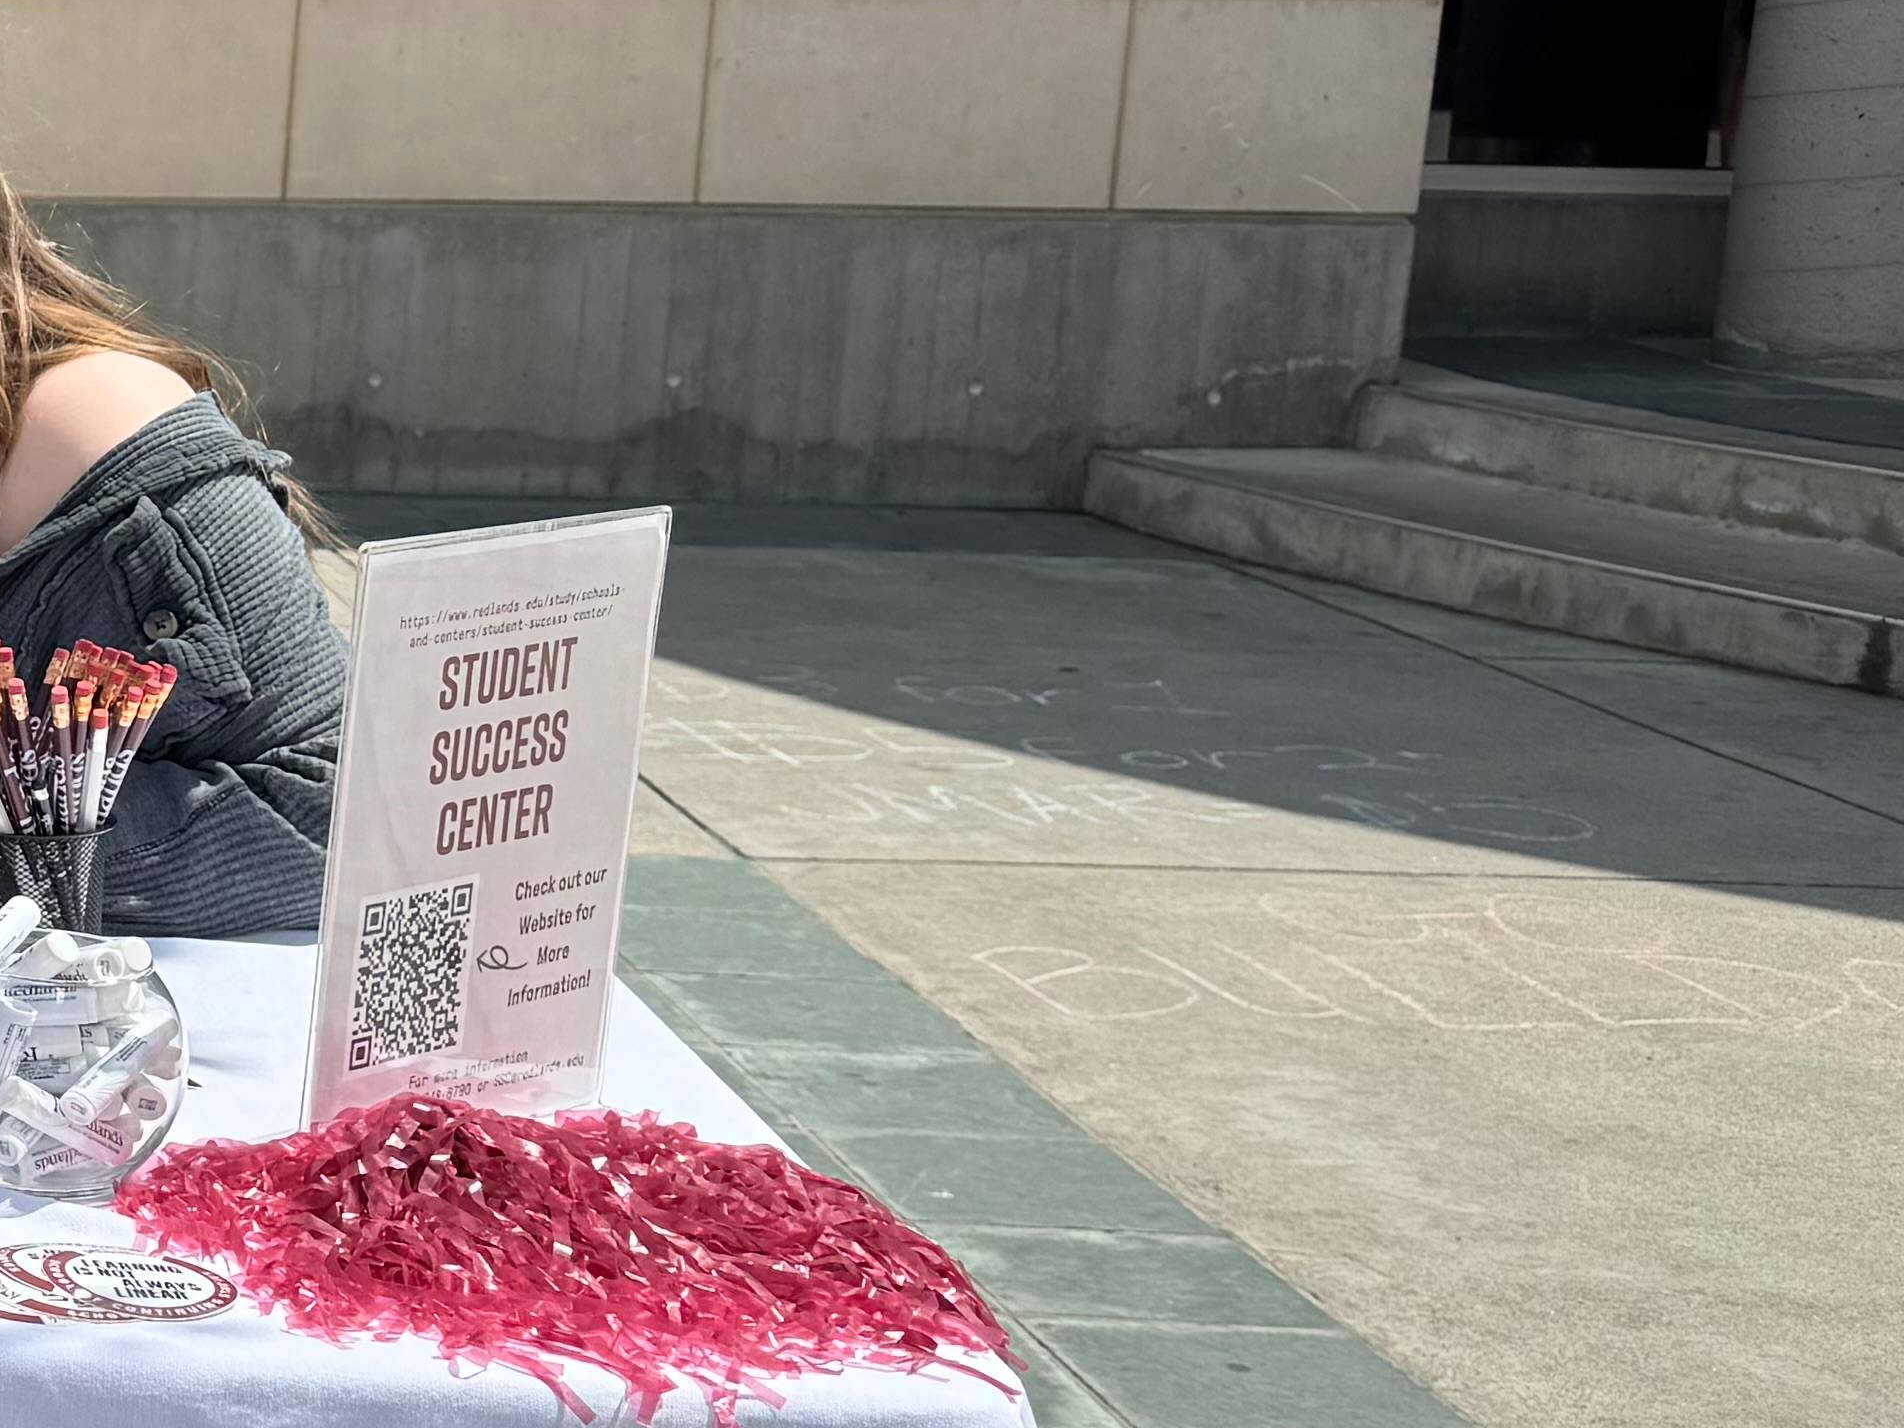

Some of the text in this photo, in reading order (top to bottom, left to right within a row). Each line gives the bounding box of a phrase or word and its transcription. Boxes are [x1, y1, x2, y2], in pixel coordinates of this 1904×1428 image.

[439, 637, 578, 710] STUDENT
[430, 709, 569, 785] SUCCESS
[436, 784, 553, 856] CENTER
[516, 868, 608, 901] Check out our
[519, 903, 596, 935] Website for
[536, 945, 570, 965] More
[507, 969, 591, 1007] Information!
[72, 1265, 93, 1276] IS
[80, 1258, 183, 1275] LEARNING
[113, 1286, 190, 1301] LINEAR
